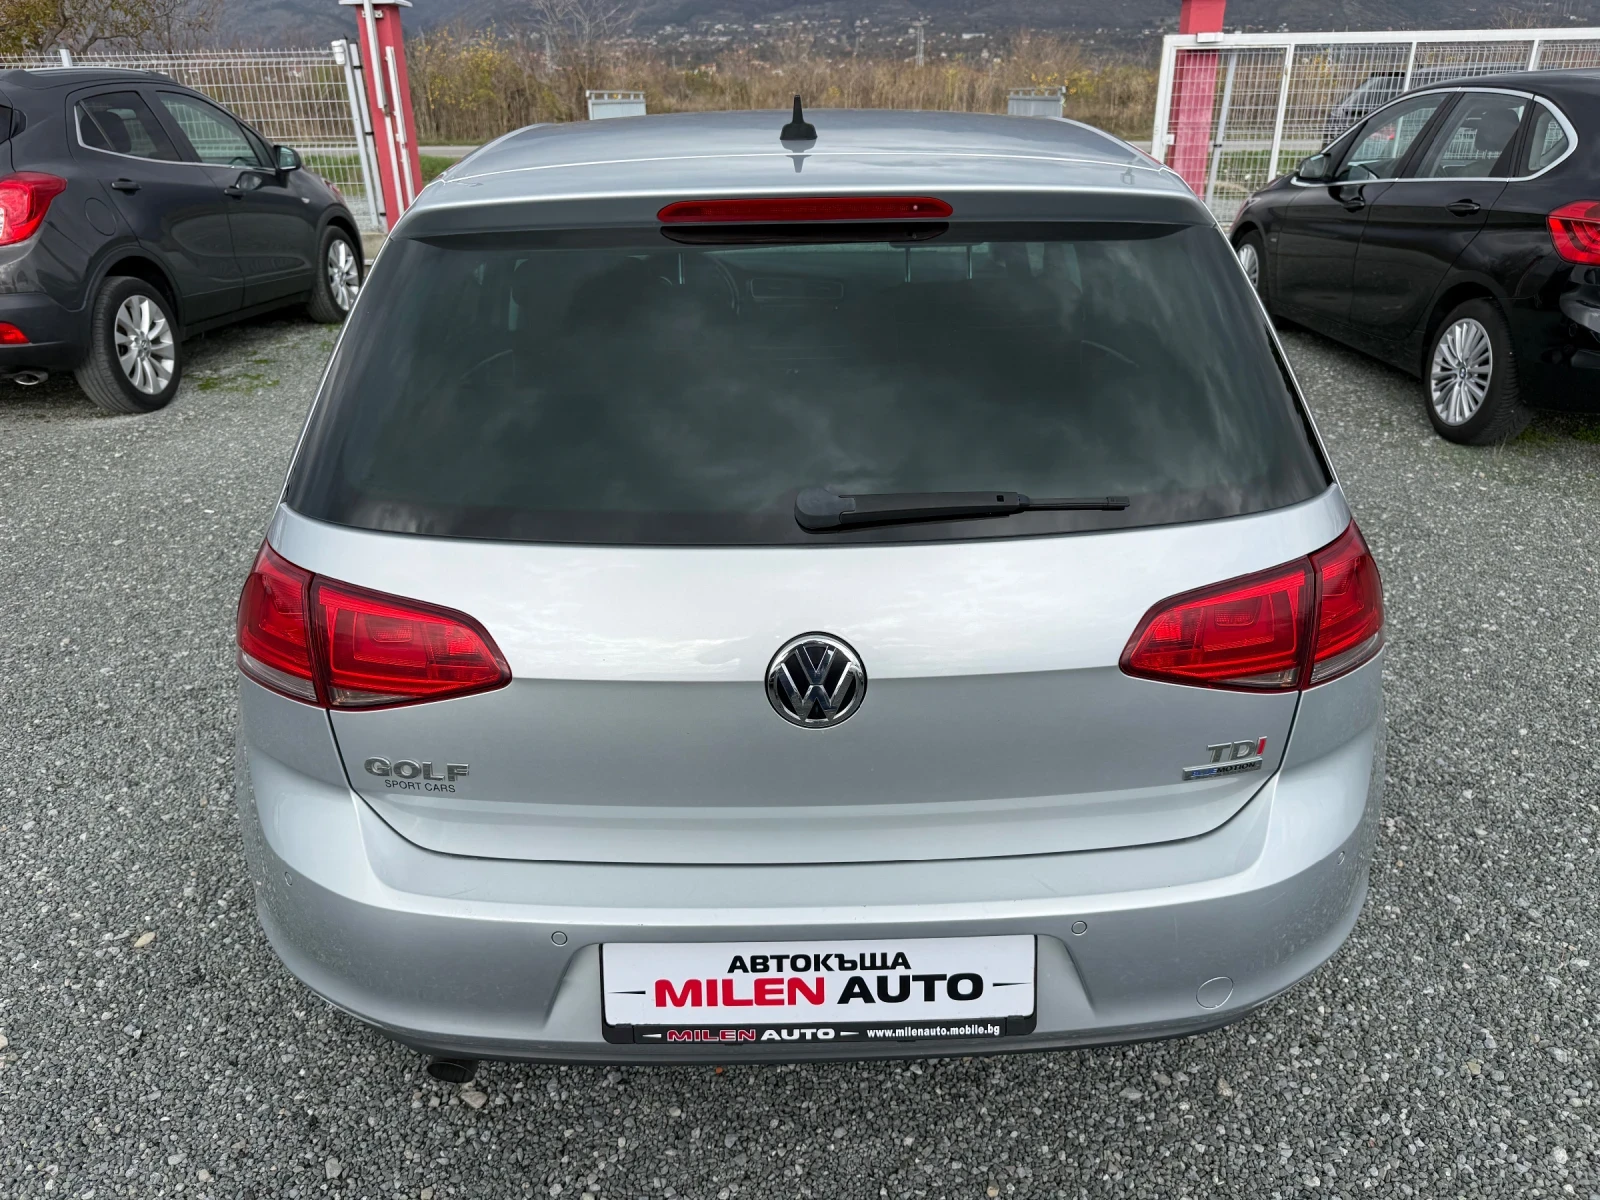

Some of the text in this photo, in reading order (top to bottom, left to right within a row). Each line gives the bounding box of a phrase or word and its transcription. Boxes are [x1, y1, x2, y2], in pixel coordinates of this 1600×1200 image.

[1206, 736, 1267, 763] TDI
[364, 756, 470, 782] GOLF
[384, 779, 456, 793] SPORT CARS
[655, 972, 984, 1008] MILEN AUTO
[667, 1028, 836, 1042] MILEN AUTO
[866, 1023, 1001, 1038] www.milenauto.mobile.bg
